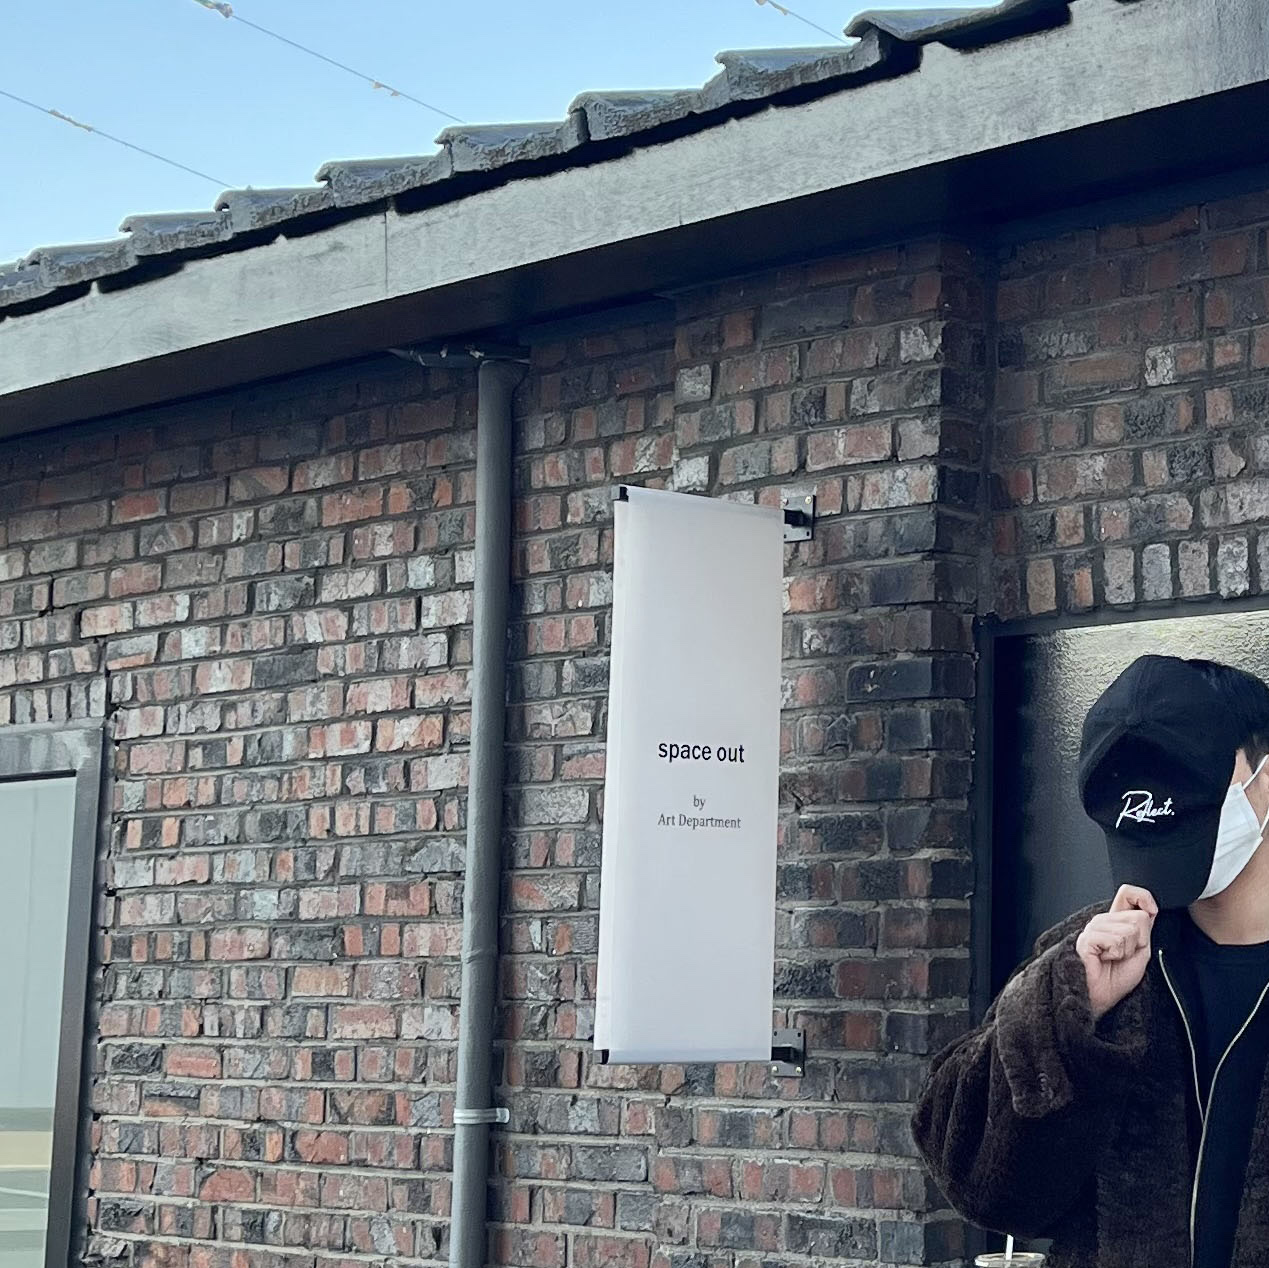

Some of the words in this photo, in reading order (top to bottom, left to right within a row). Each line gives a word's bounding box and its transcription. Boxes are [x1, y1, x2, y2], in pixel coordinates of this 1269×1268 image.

[658, 743, 712, 763] space
[716, 745, 745, 763] out
[693, 795, 706, 811] by
[658, 813, 676, 826] Art
[678, 814, 742, 830] Department
